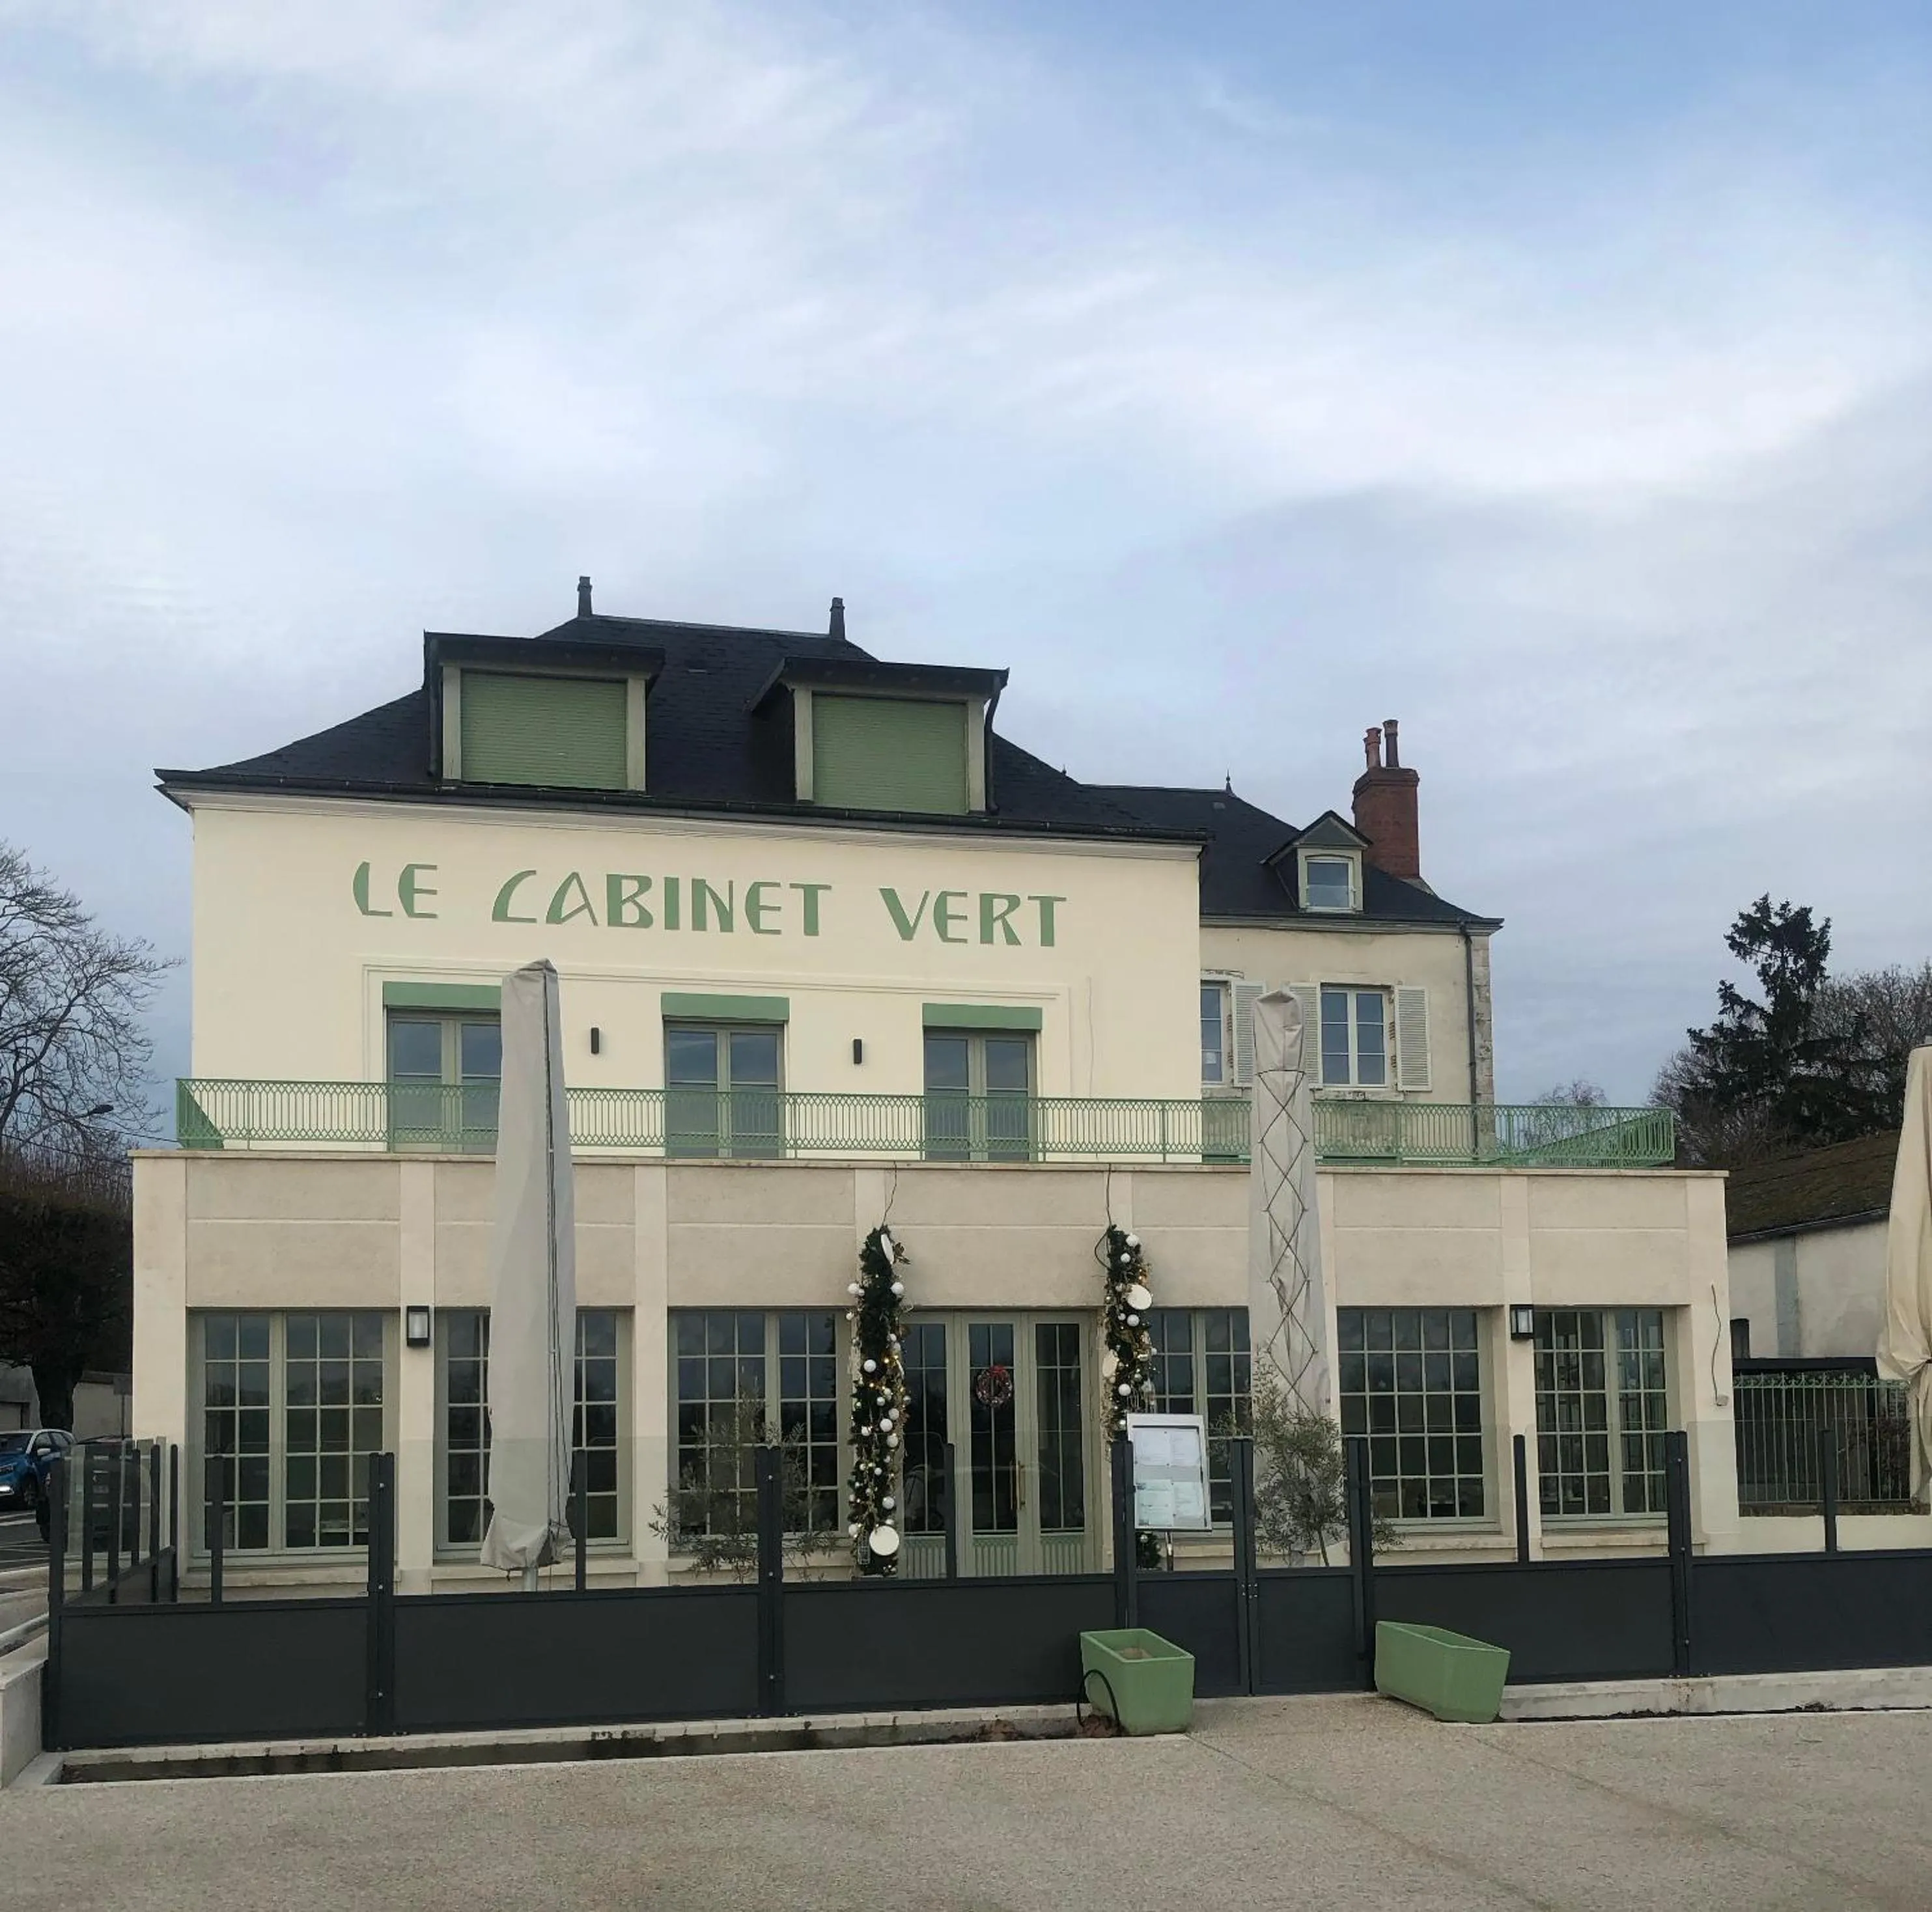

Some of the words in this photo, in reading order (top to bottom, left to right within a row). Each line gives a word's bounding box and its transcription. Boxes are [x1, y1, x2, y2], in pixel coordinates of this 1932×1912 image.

[352, 861, 438, 919] LE
[492, 869, 832, 937] CABINET
[878, 887, 1067, 947] VERT
